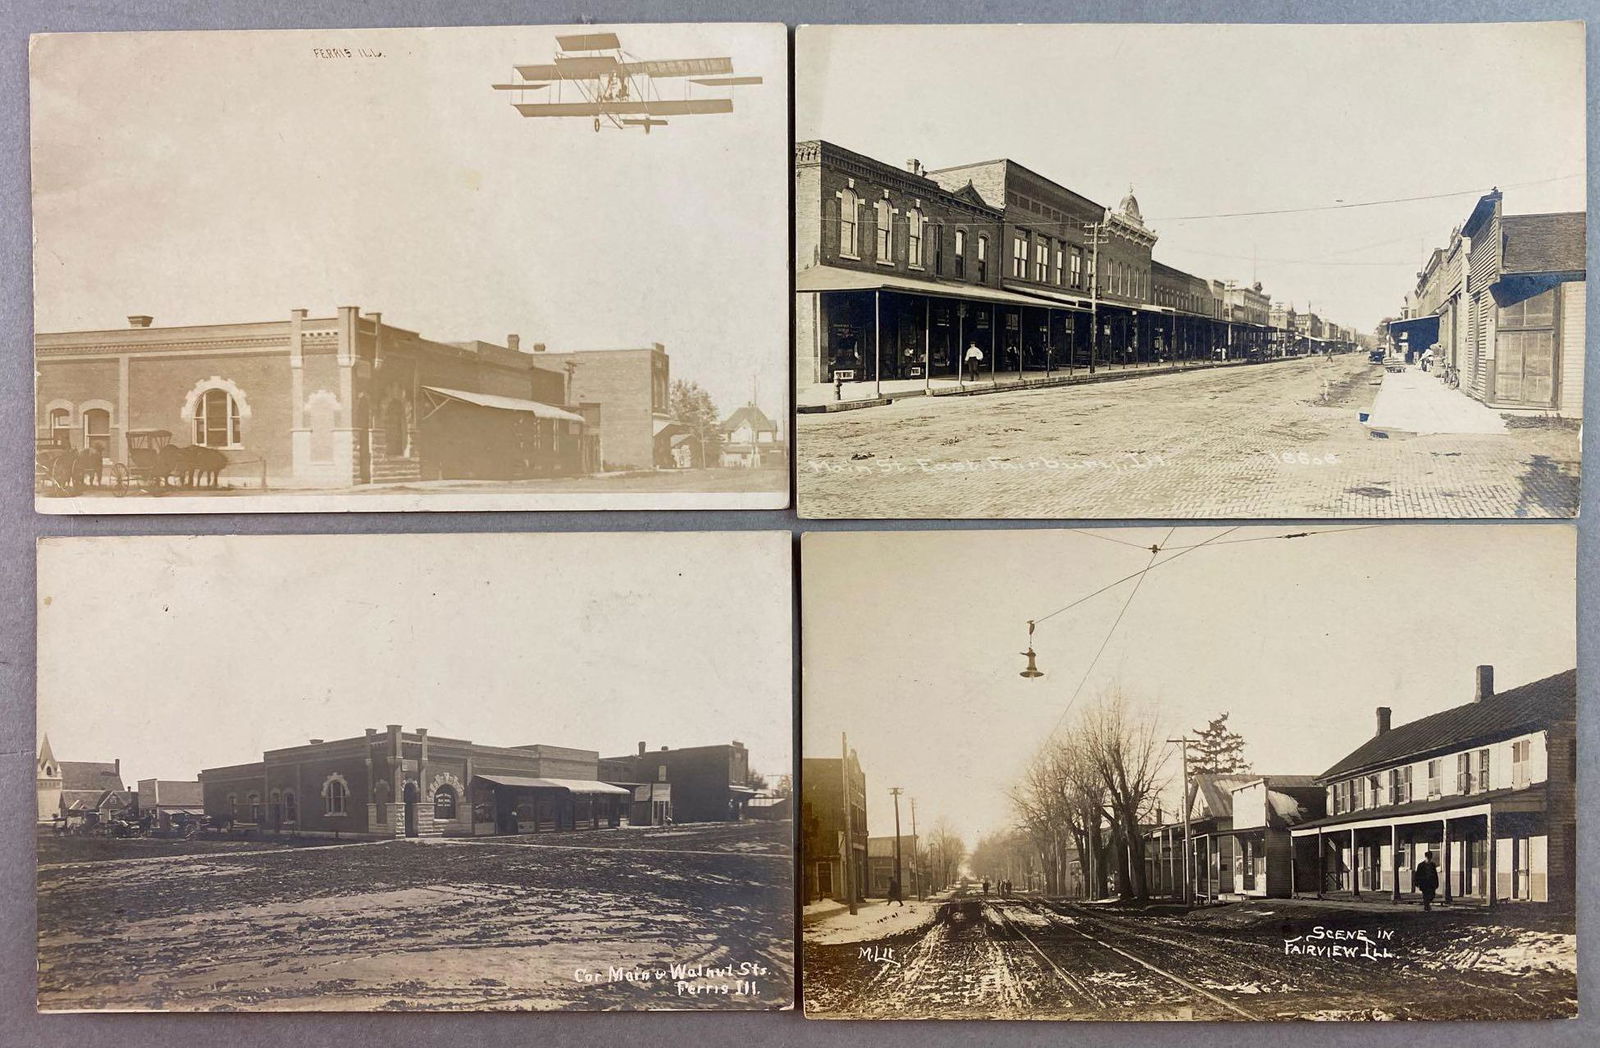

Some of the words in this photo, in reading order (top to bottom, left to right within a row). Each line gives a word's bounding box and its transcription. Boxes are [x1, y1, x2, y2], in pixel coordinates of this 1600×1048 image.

[313, 48, 352, 59] FERRIS
[608, 965, 650, 983] Main
[669, 963, 733, 980] Walnut
[675, 980, 729, 996] Ferris
